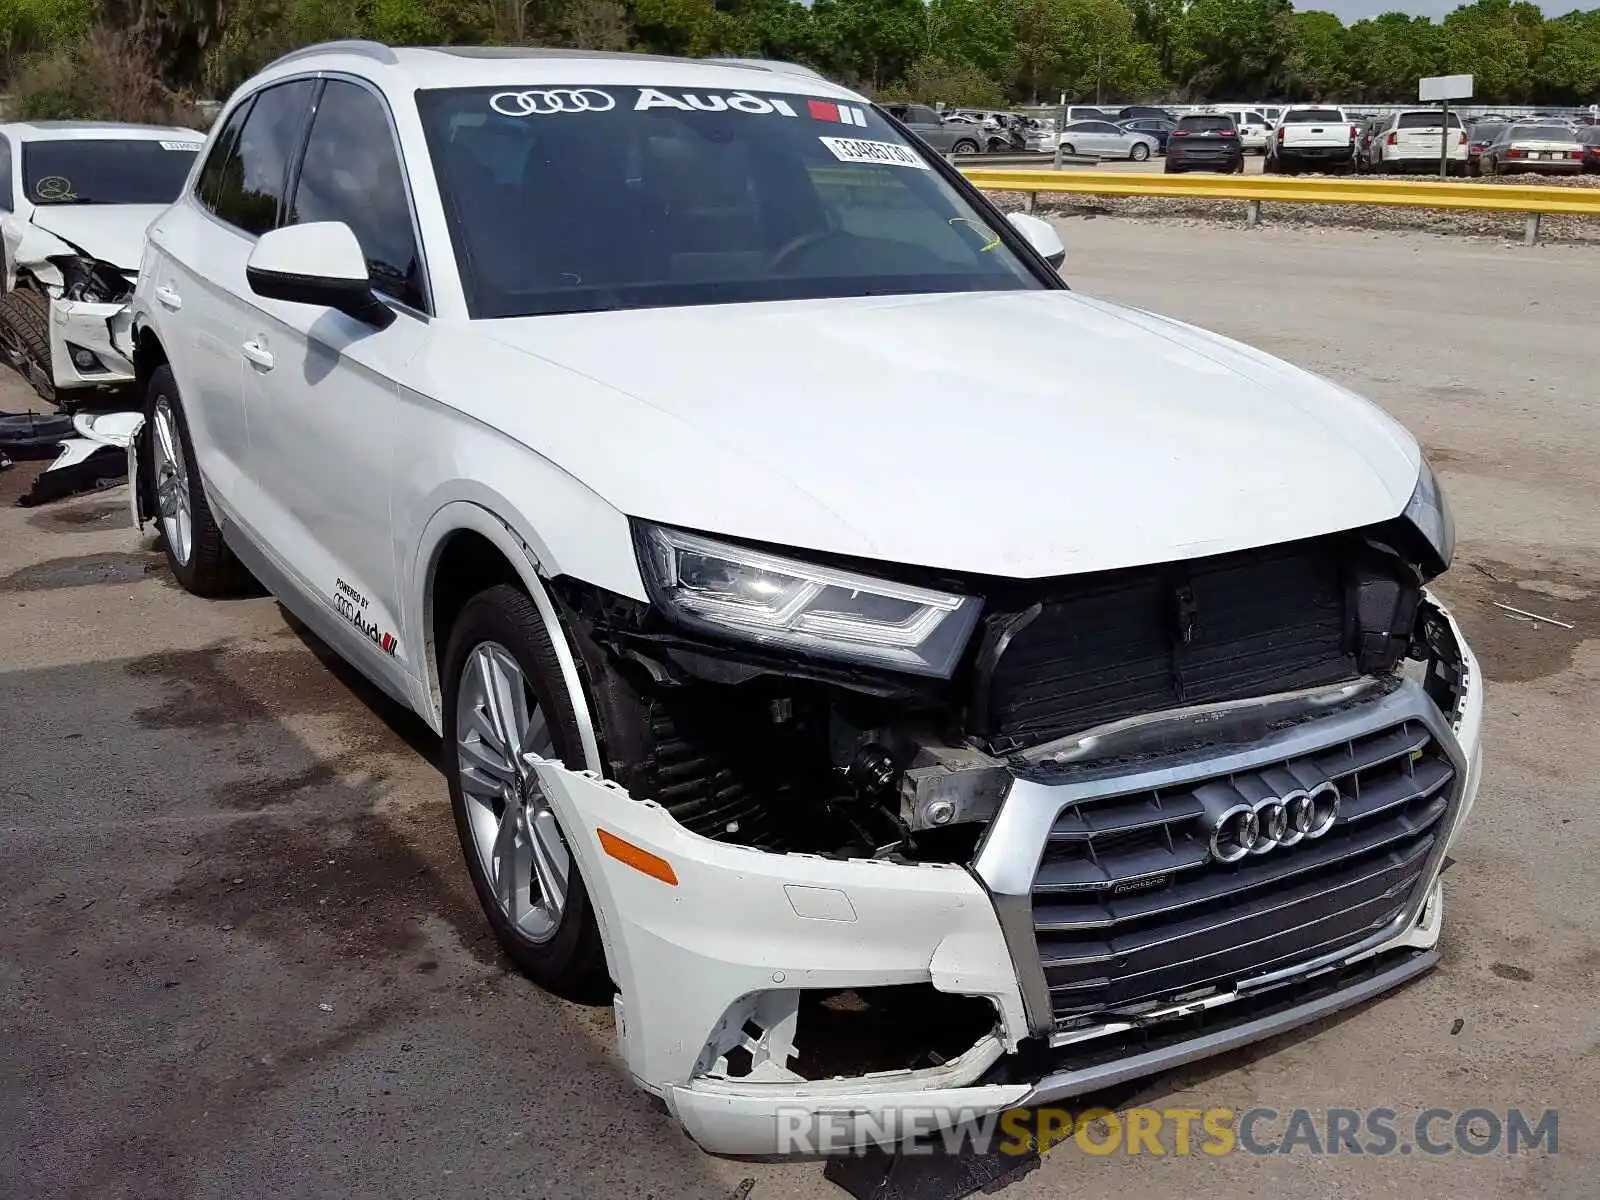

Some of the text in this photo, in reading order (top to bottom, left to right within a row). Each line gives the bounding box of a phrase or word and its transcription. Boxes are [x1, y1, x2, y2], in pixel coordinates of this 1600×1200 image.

[634, 88, 798, 117] Audi
[834, 139, 914, 163] 33485730
[335, 577, 370, 610] POWERED BY
[353, 609, 382, 647] Audi
